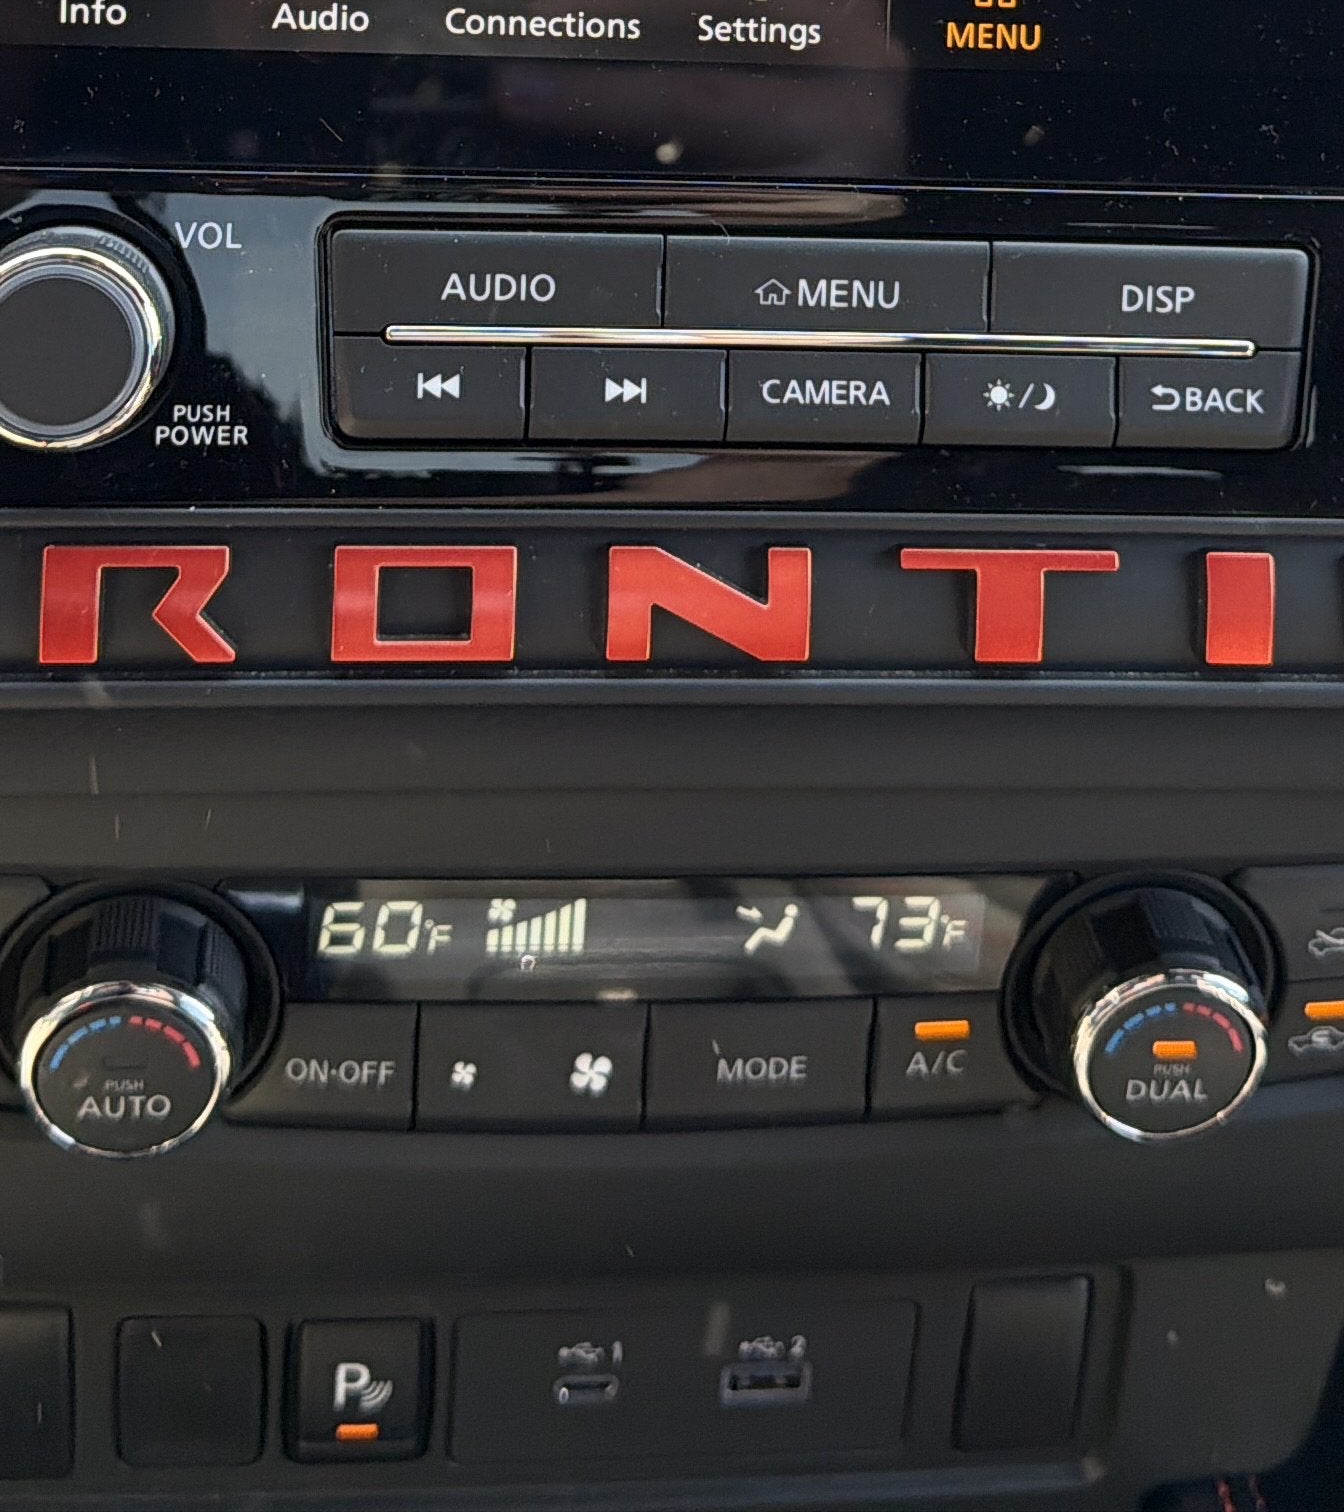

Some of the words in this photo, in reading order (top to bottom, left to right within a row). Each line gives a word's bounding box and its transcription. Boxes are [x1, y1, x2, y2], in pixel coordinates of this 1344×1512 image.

[271, 2, 370, 32] Audio
[444, 8, 642, 40] Connections
[697, 14, 821, 51] Settings
[945, 21, 1042, 51] MENU
[174, 221, 243, 250] VOL
[440, 273, 557, 303] AUDIO
[797, 279, 901, 310] MENU
[1121, 285, 1195, 314] DISP
[761, 378, 891, 407] CAMERA
[1185, 388, 1265, 414] BACK
[172, 403, 231, 425] PUSH
[155, 424, 249, 447] POWER
[716, 1055, 809, 1084] MODE
[906, 1049, 969, 1078] A/C
[104, 1078, 145, 1093] PUSH
[1124, 1079, 1208, 1103] DUAL
[76, 1093, 172, 1122] AUTO
